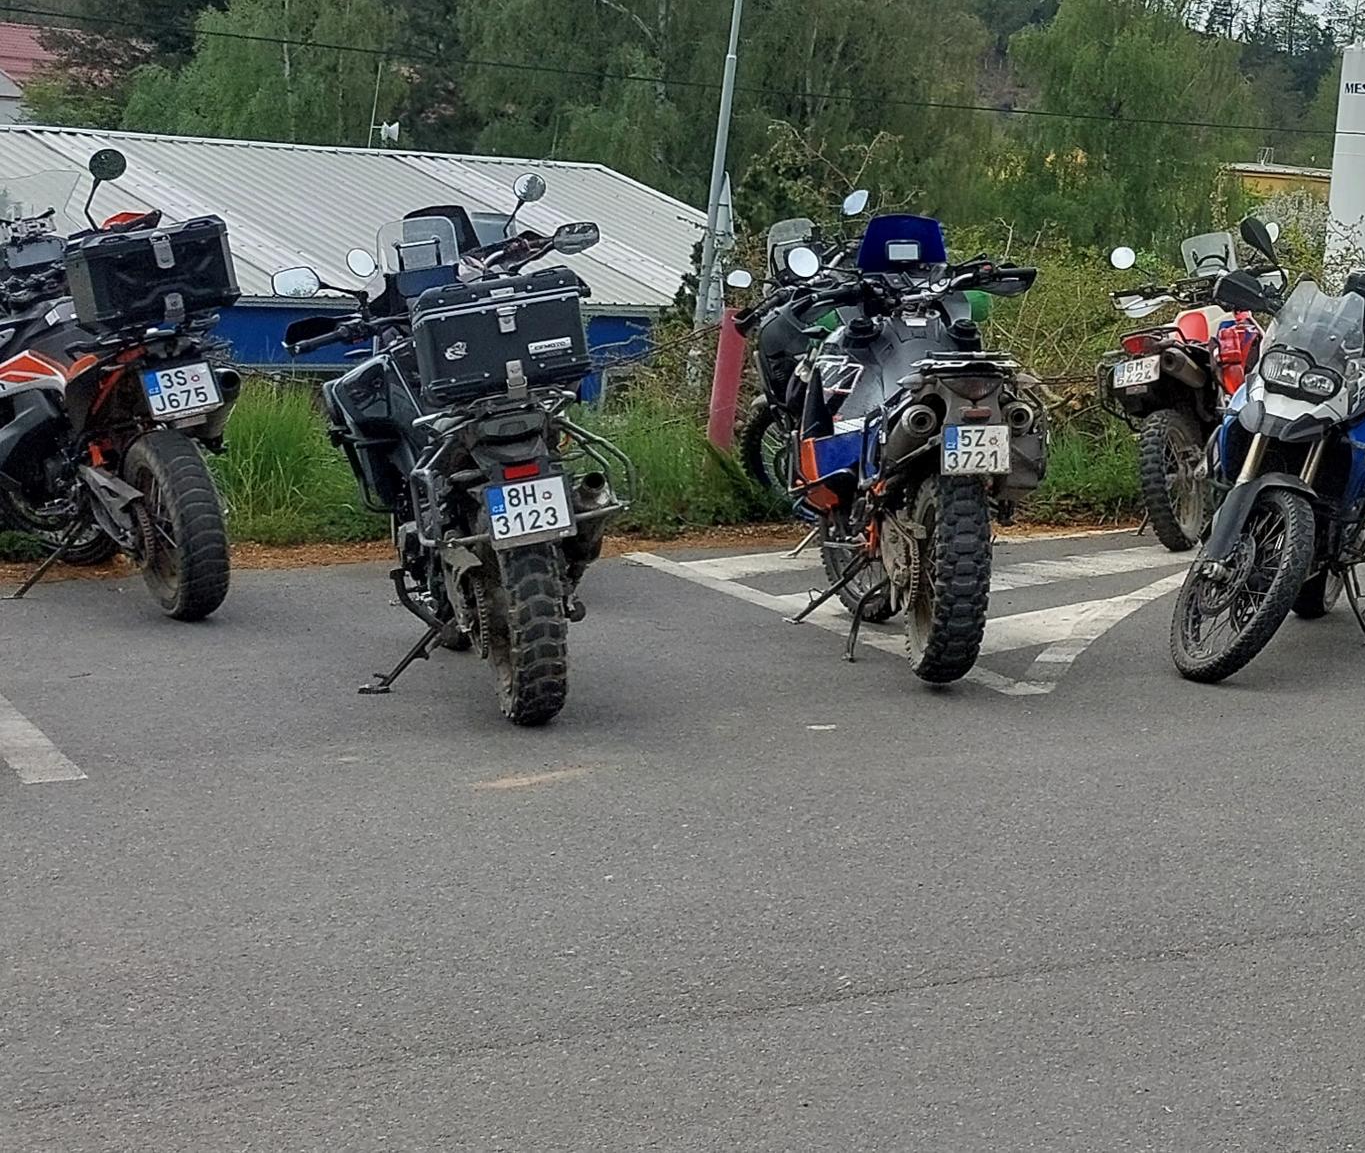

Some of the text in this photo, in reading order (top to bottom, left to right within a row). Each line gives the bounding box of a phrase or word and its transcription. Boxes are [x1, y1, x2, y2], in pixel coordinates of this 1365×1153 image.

[1126, 360, 1144, 373] 6M
[160, 370, 188, 389] 3S
[155, 386, 208, 412] J675
[961, 429, 986, 447] 5Z
[947, 450, 998, 470] 3721
[507, 484, 538, 507] 8H
[492, 504, 505, 513] CZ
[496, 506, 559, 535] 3123
